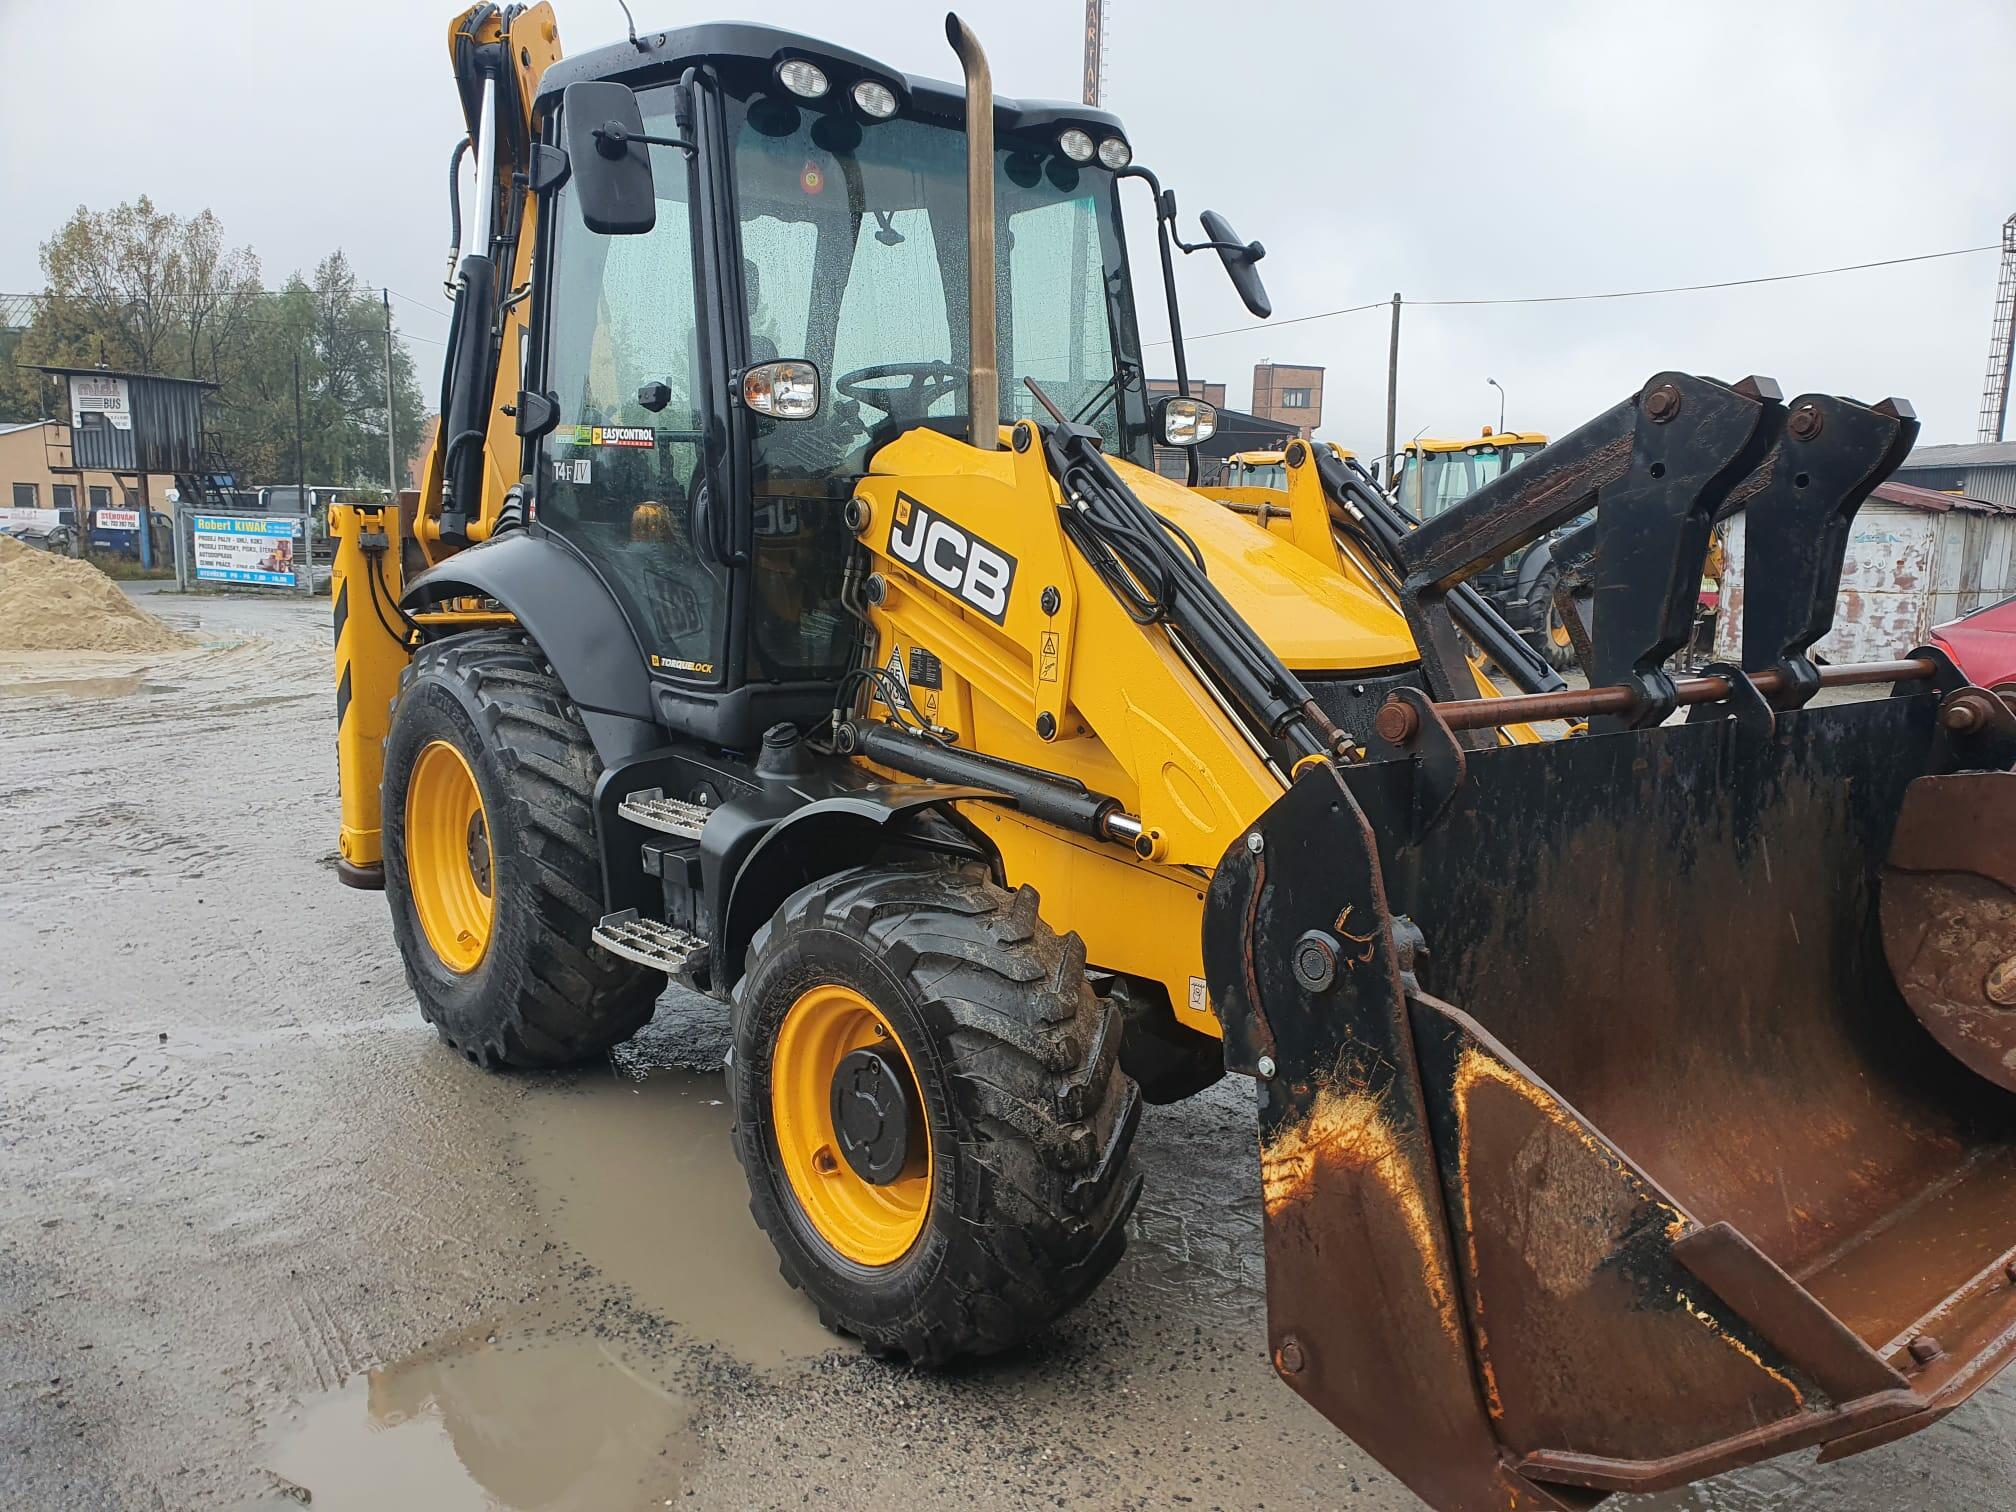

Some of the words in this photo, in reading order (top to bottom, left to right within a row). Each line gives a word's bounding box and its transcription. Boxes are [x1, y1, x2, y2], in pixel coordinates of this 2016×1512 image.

[1086, 0, 1096, 104] ARTAK
[104, 398, 121, 409] BUS
[602, 428, 654, 444] EASYCONTROL
[198, 519, 231, 531] Robert
[235, 520, 268, 533] KIWAK
[891, 509, 1010, 616] JCB
